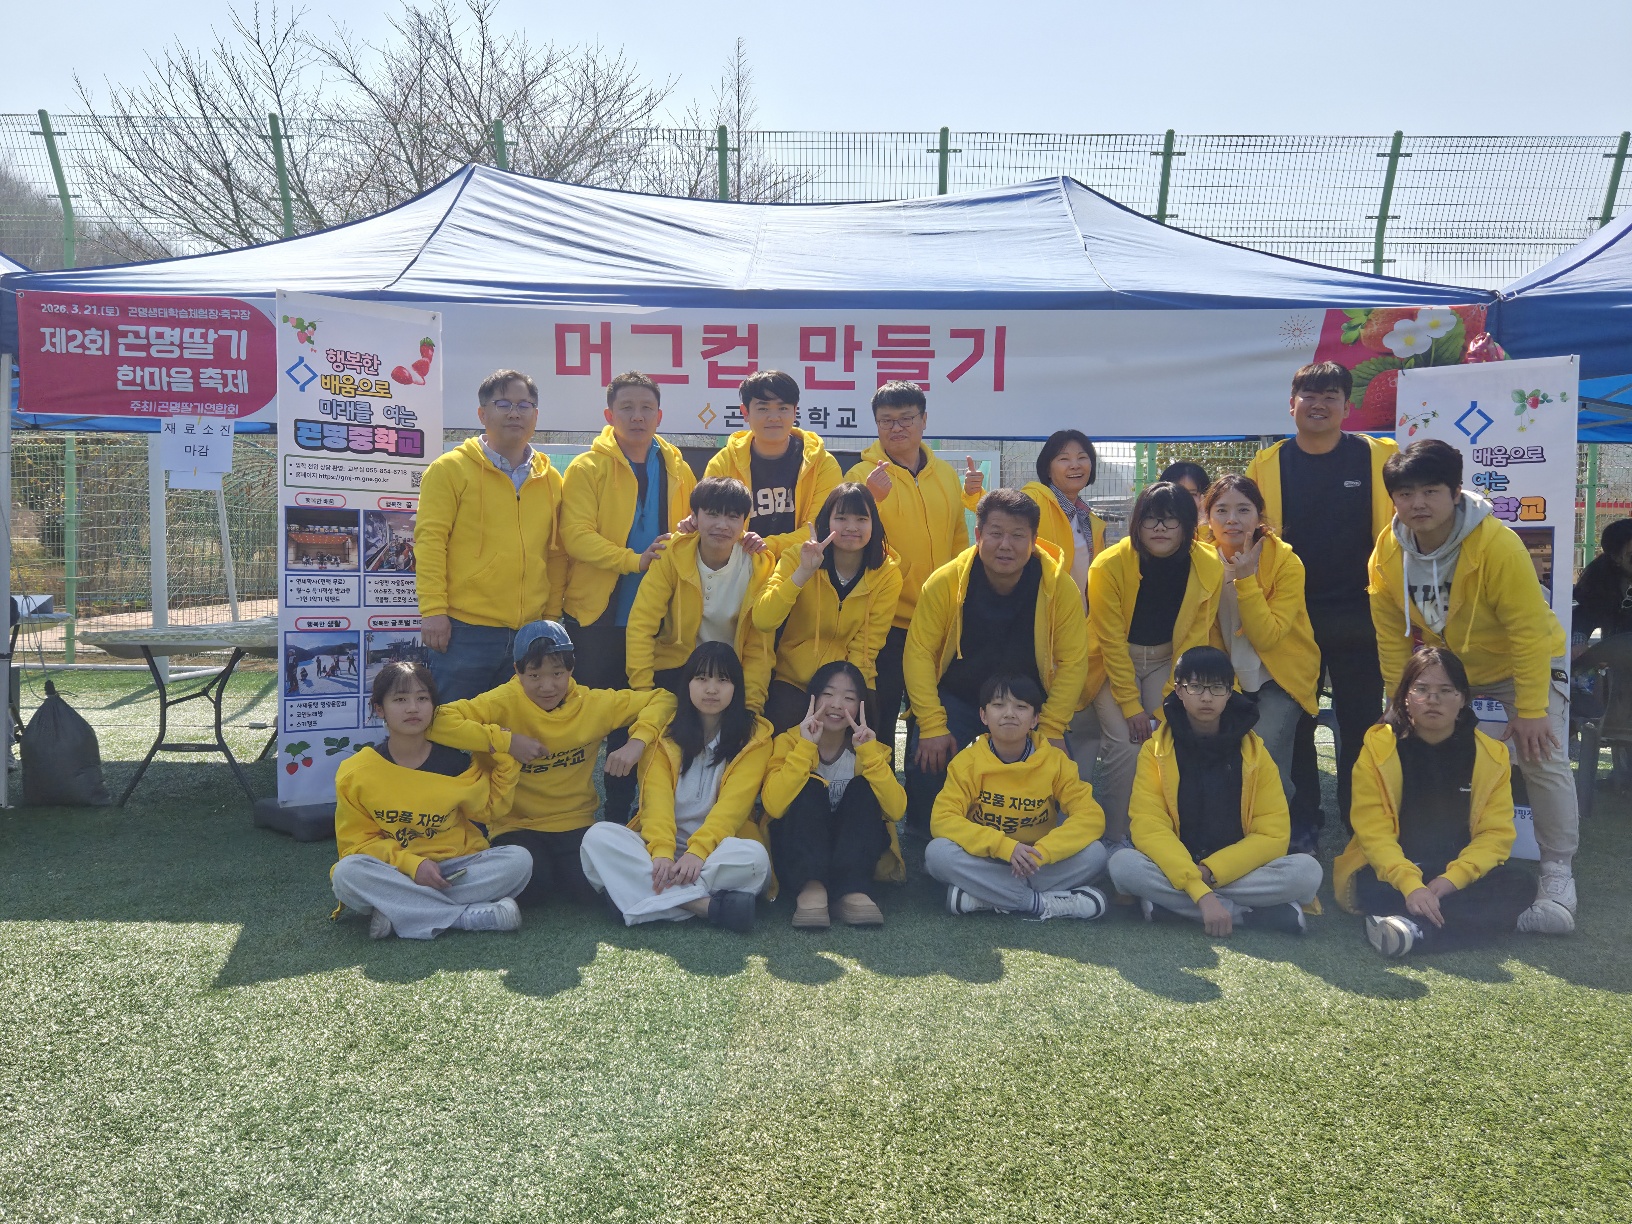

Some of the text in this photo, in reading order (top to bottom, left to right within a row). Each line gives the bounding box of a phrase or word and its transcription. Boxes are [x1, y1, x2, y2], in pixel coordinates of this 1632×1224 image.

[40, 304, 69, 314] 2026.
[71, 304, 83, 314] 3.
[40, 325, 248, 360] 제2회 곤명딸기
[326, 349, 381, 376] 행복한
[555, 321, 1007, 392] 머그컵 만들기
[117, 364, 249, 394] 한마음 축제
[320, 374, 392, 398] 배움으로
[130, 401, 239, 415] 주최 곤명딸기연합회
[319, 399, 418, 427] 미래를 여는
[723, 405, 858, 429] 곤학교
[184, 444, 210, 457] 마감
[294, 419, 425, 458] 곤명중학교
[1472, 445, 1546, 467] 배움으로
[1472, 470, 1510, 491] 여는
[1486, 496, 1546, 522] 학교
[977, 790, 1005, 808] 모품
